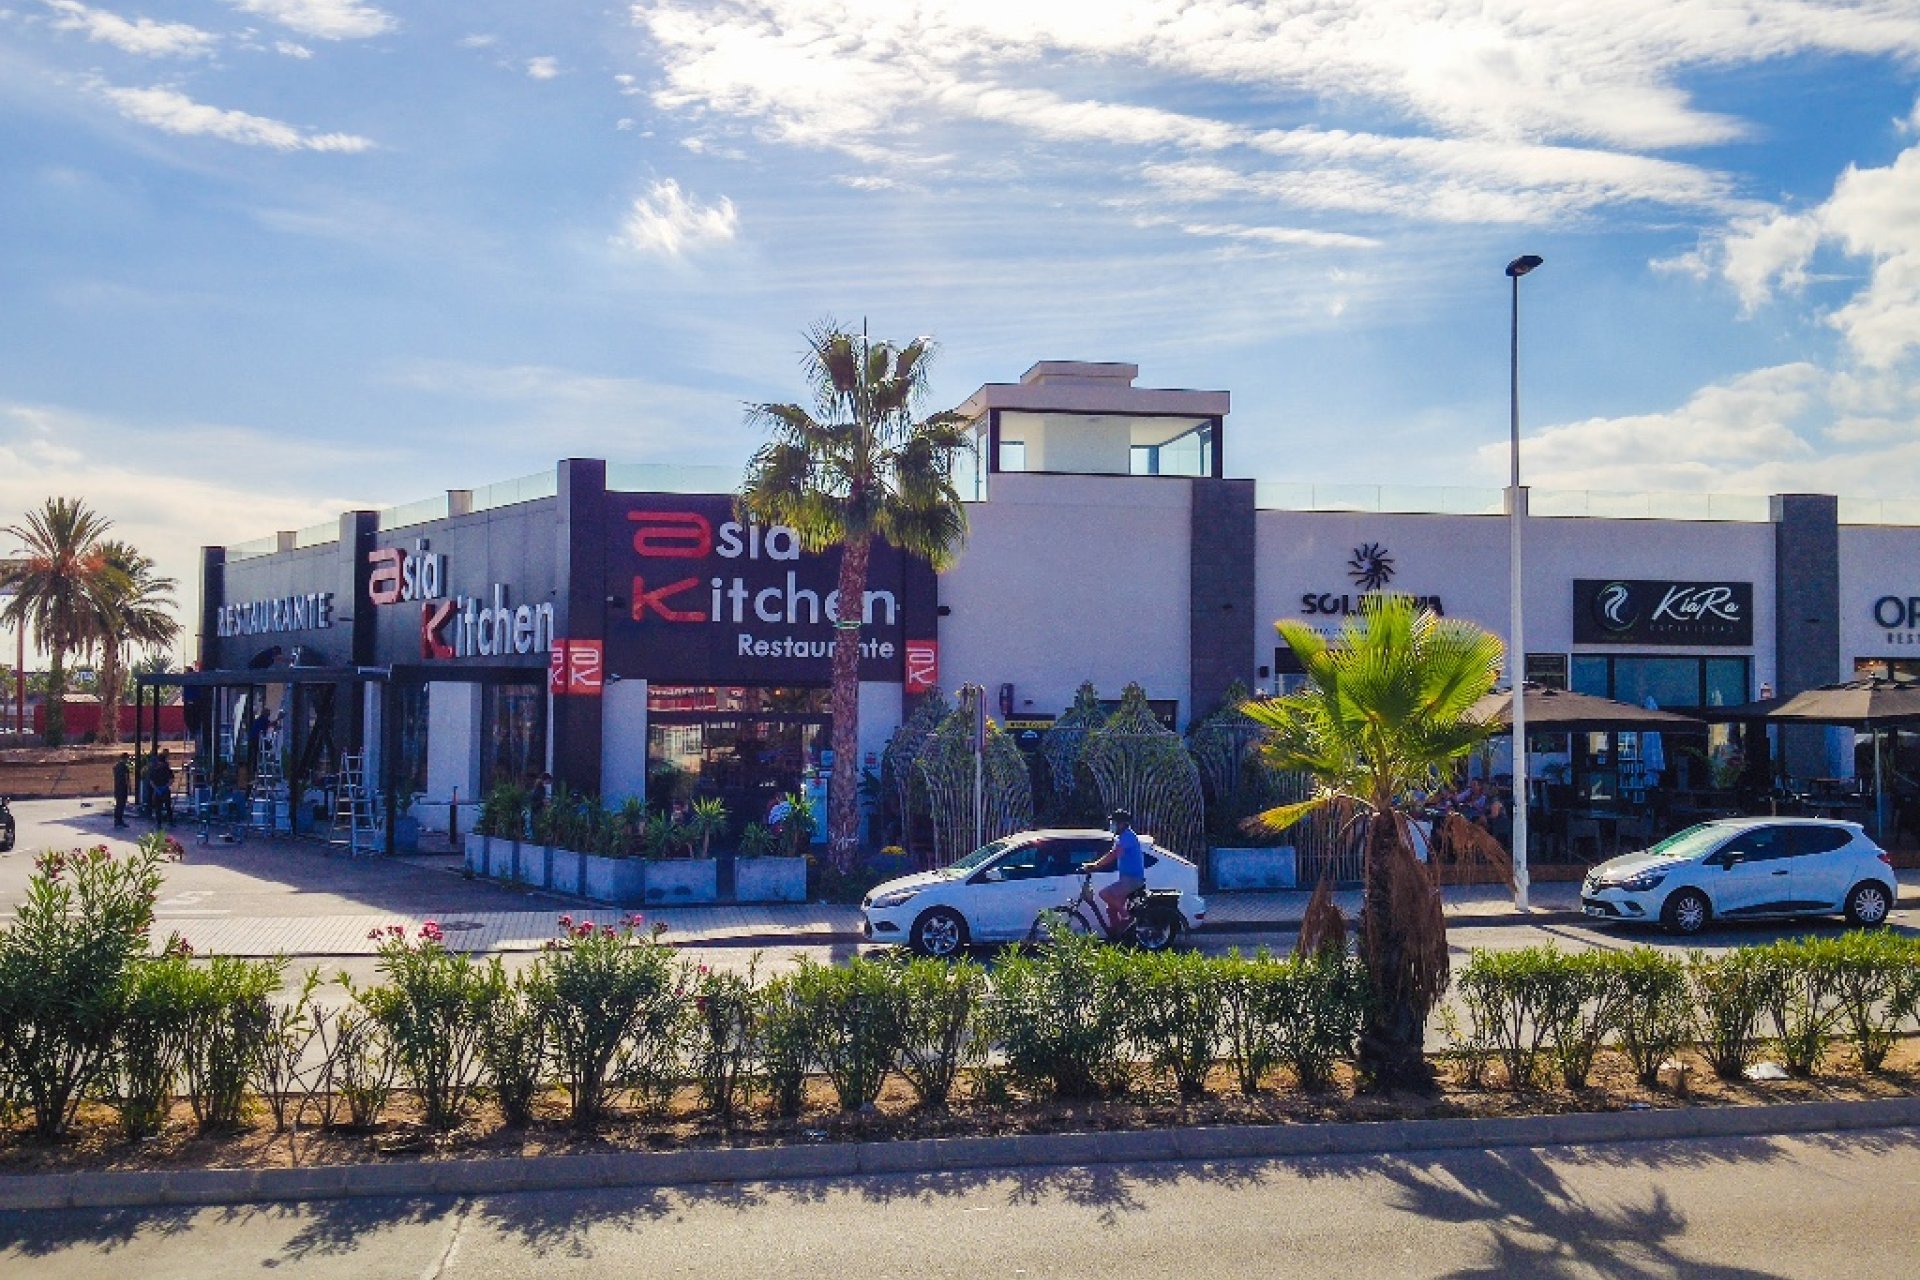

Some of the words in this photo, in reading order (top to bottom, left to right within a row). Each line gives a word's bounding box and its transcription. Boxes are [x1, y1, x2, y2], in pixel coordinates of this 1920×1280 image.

[217, 592, 334, 637] RESTAURANTE
[421, 583, 554, 661] Kitchen
[738, 633, 895, 659] Restaurnte
